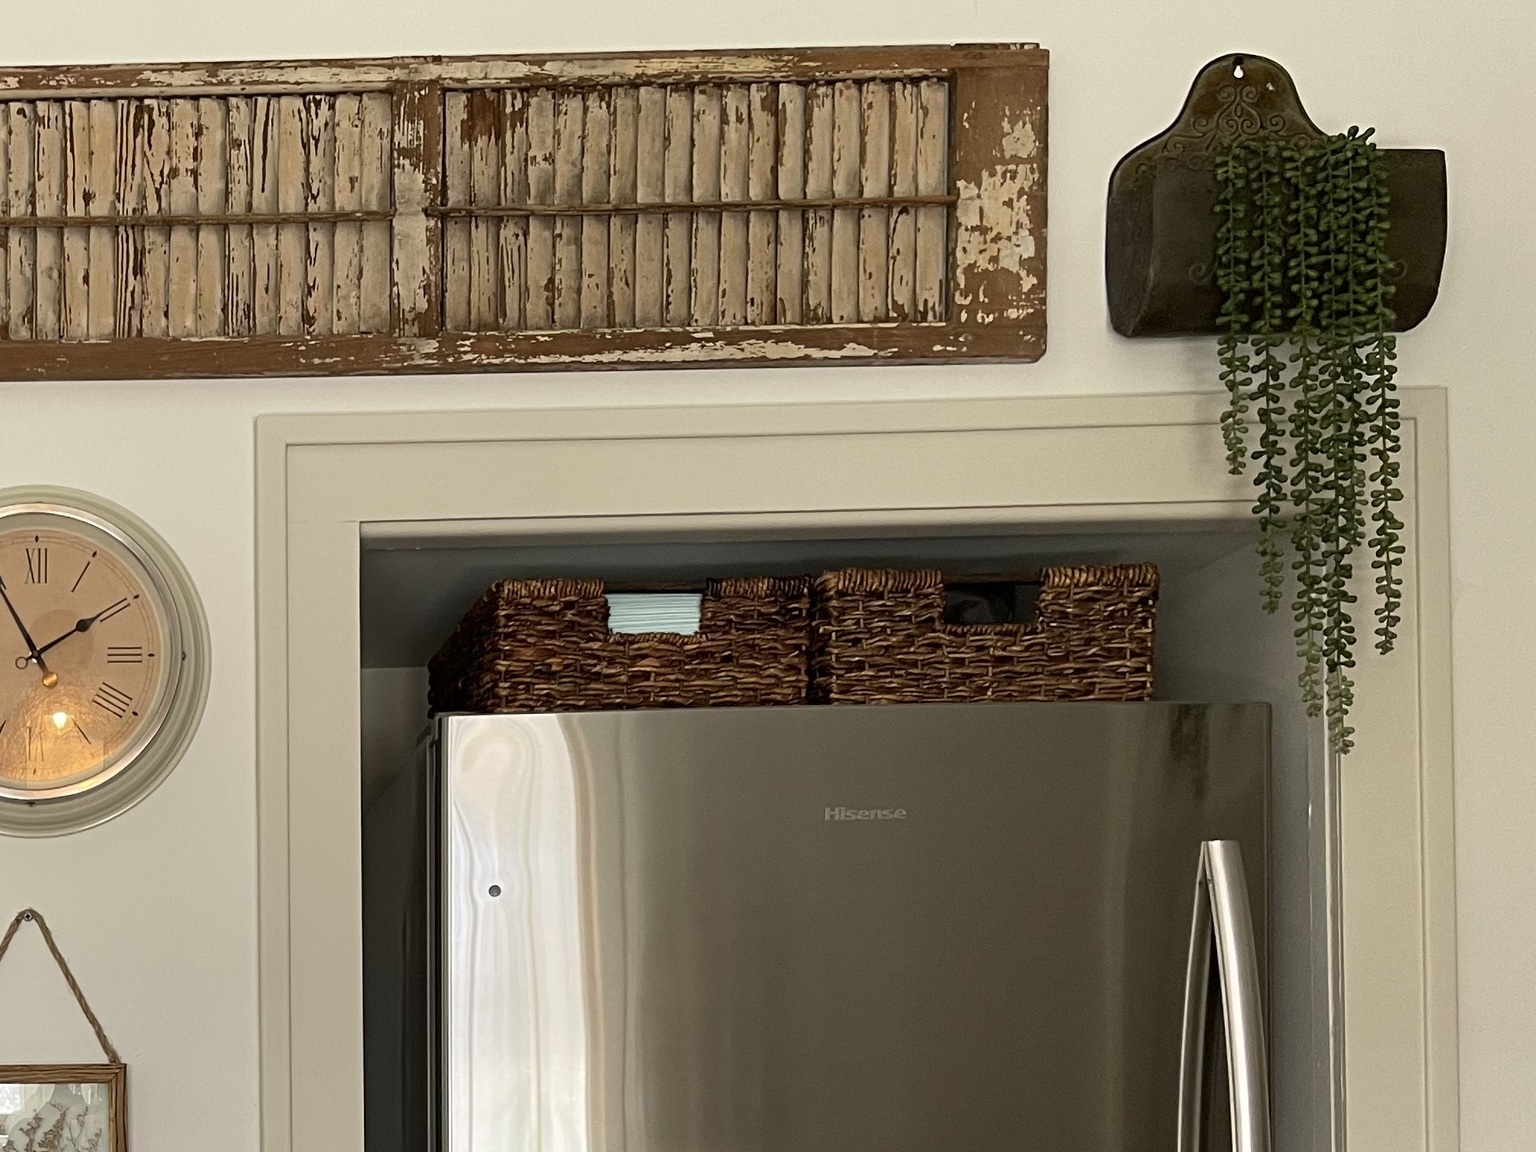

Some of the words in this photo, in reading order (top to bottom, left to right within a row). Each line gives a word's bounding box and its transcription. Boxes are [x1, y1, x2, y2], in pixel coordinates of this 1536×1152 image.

[24, 548, 48, 584] XII
[70, 561, 91, 593] I
[106, 646, 143, 664] III
[91, 681, 133, 719] IIII
[824, 806, 907, 821] Hisense
